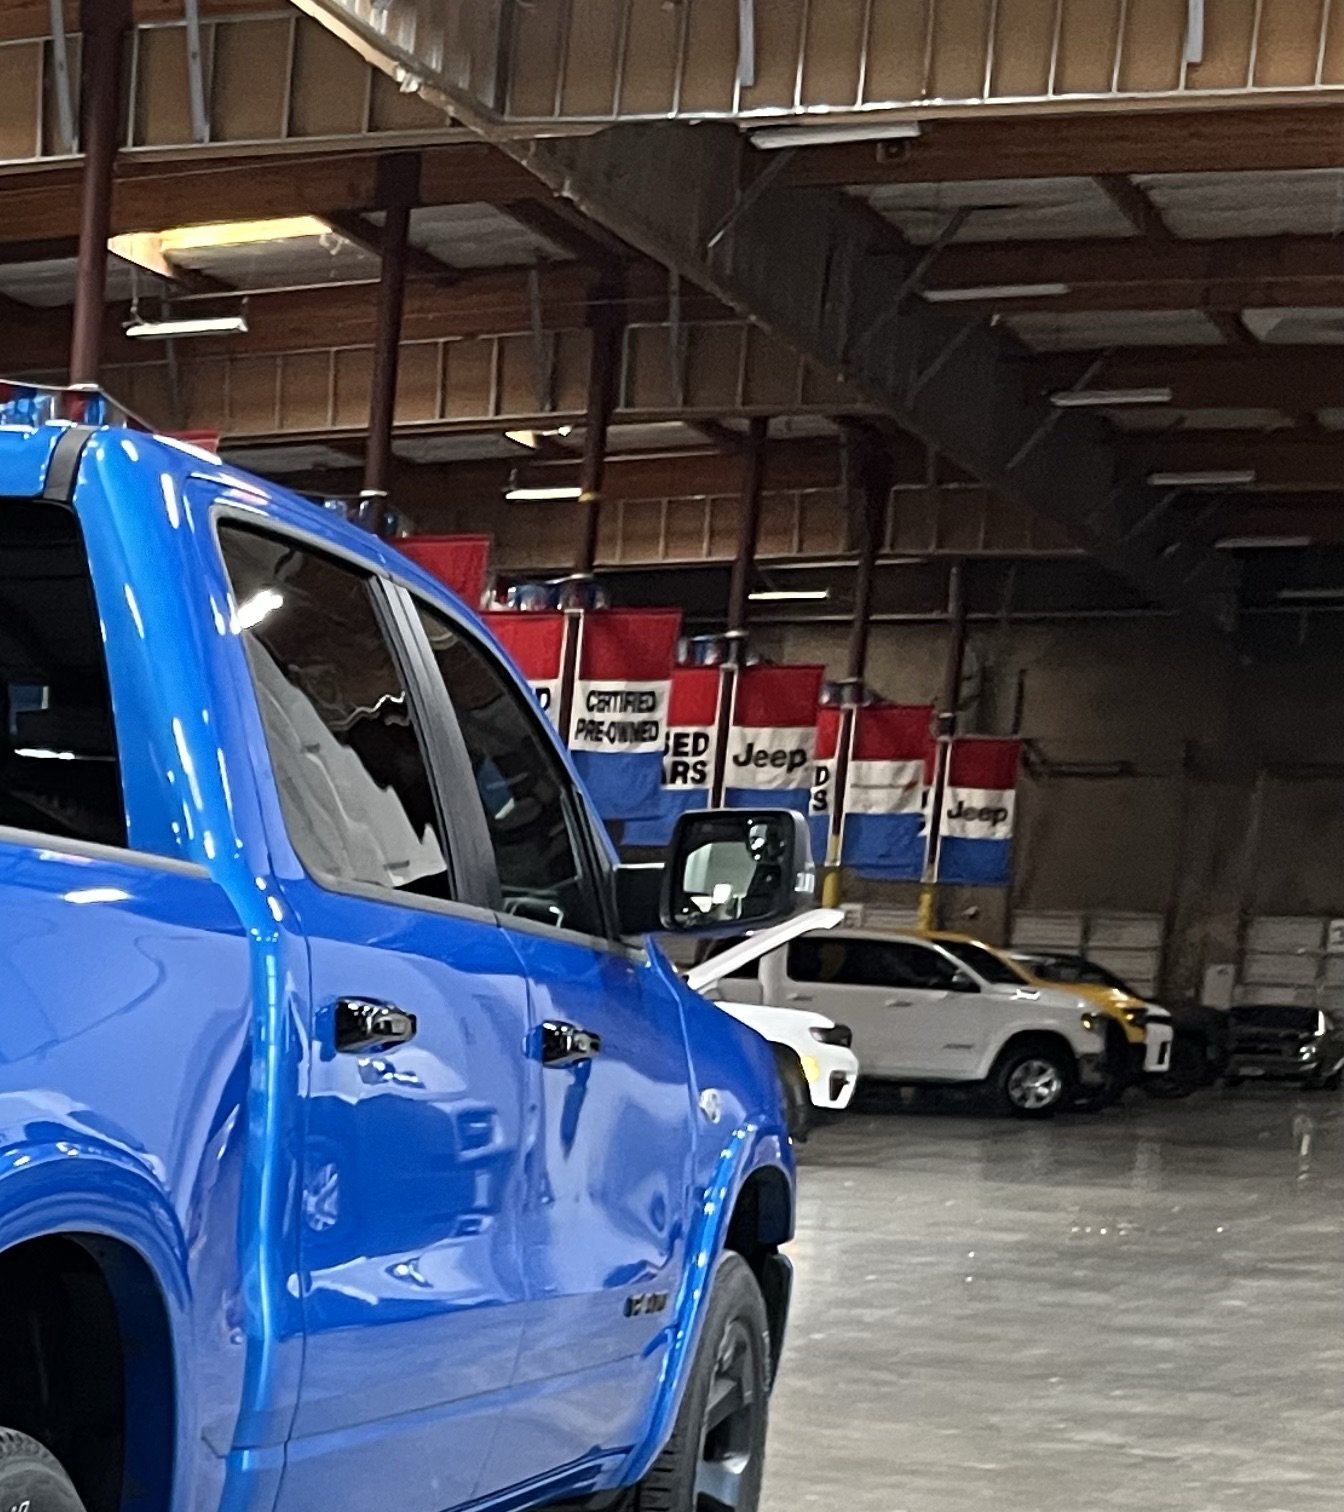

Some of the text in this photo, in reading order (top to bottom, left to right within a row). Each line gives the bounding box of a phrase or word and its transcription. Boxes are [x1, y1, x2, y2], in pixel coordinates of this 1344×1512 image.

[586, 689, 656, 713] CERTIFIED
[575, 718, 660, 744] PRE-OWNED
[732, 742, 807, 773] Jeep
[946, 801, 1008, 827] Jeep
